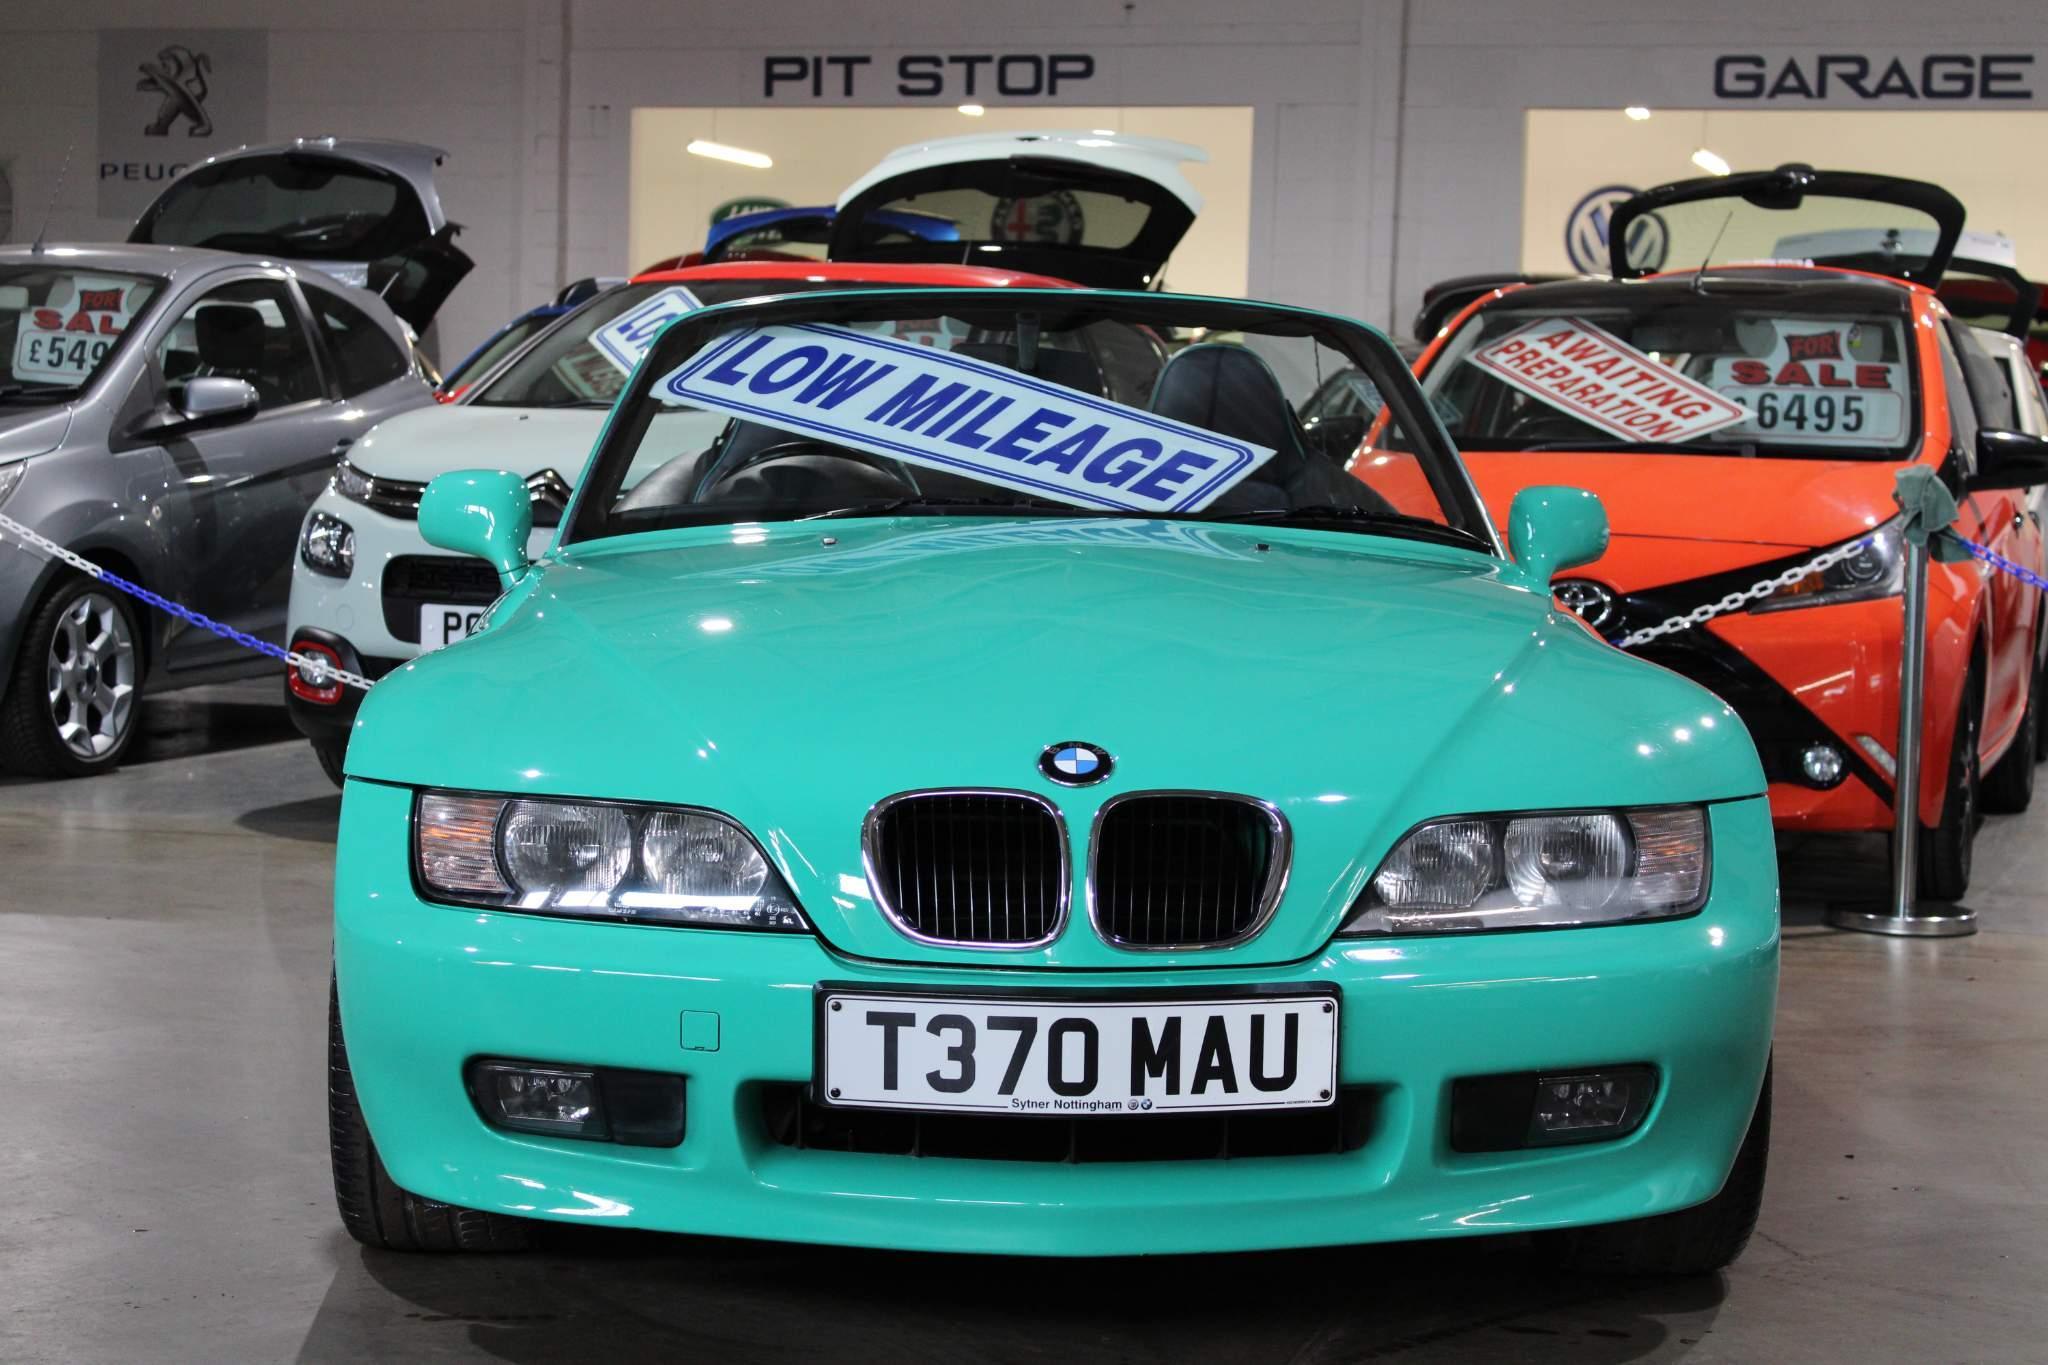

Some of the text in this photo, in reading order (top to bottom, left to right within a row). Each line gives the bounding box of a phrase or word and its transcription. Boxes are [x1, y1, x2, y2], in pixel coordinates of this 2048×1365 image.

[763, 53, 1096, 98] PIT STOP
[1714, 54, 2035, 100] GARAGE
[616, 301, 680, 350] LO
[1788, 333, 1838, 360] FOR
[1490, 339, 1684, 438] PREPARATION
[1538, 329, 1712, 421] AWAITING
[1731, 360, 1891, 389] SALE
[702, 335, 899, 411] LOW
[864, 373, 1219, 502] MILEAGE
[866, 1010, 1300, 1097] T370 MAU
[1011, 1098, 1123, 1112] Sytner Nottingham
